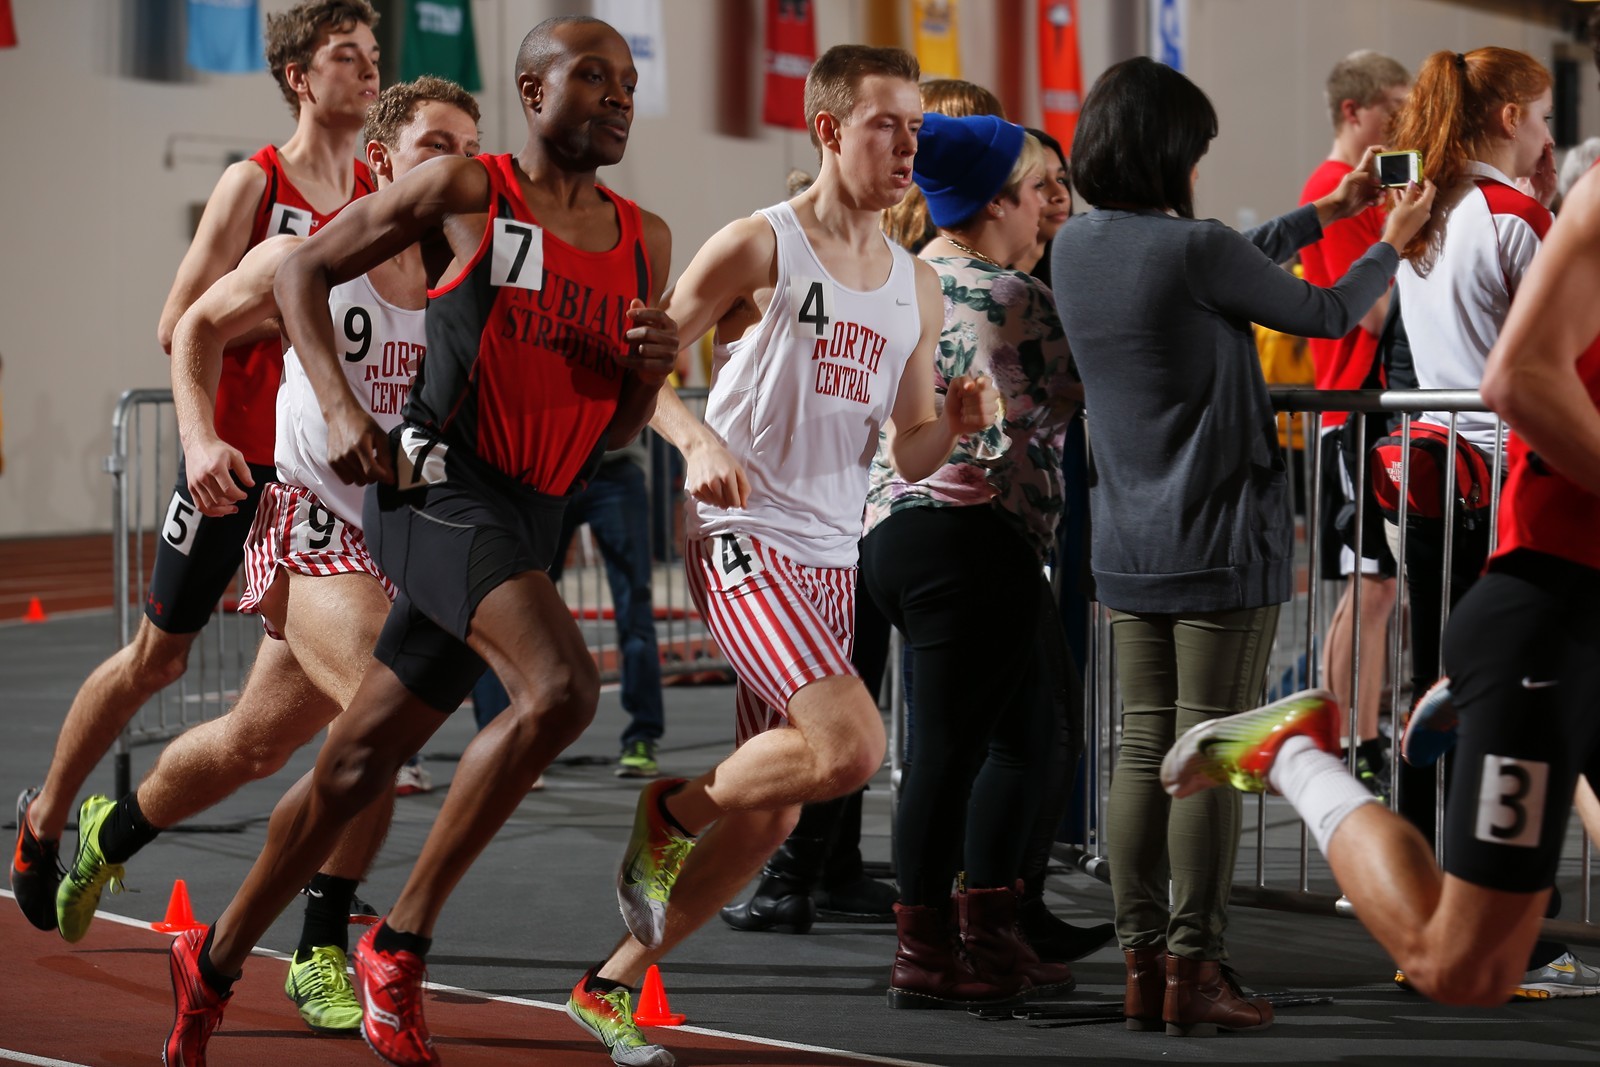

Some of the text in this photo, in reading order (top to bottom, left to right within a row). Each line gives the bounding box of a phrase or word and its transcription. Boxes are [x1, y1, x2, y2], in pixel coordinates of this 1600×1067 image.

[278, 209, 303, 236] 5
[505, 224, 533, 284] 7
[343, 306, 372, 363] 9
[798, 281, 829, 336] 4
[502, 304, 619, 381] STRIDERS
[811, 321, 888, 375] NORTH
[370, 381, 412, 415] CENT
[815, 361, 871, 405] CENTRAL
[411, 431, 441, 484] 7
[167, 500, 194, 546] 5
[308, 503, 335, 549] 9
[721, 533, 752, 576] 4
[1489, 764, 1531, 840] 3
